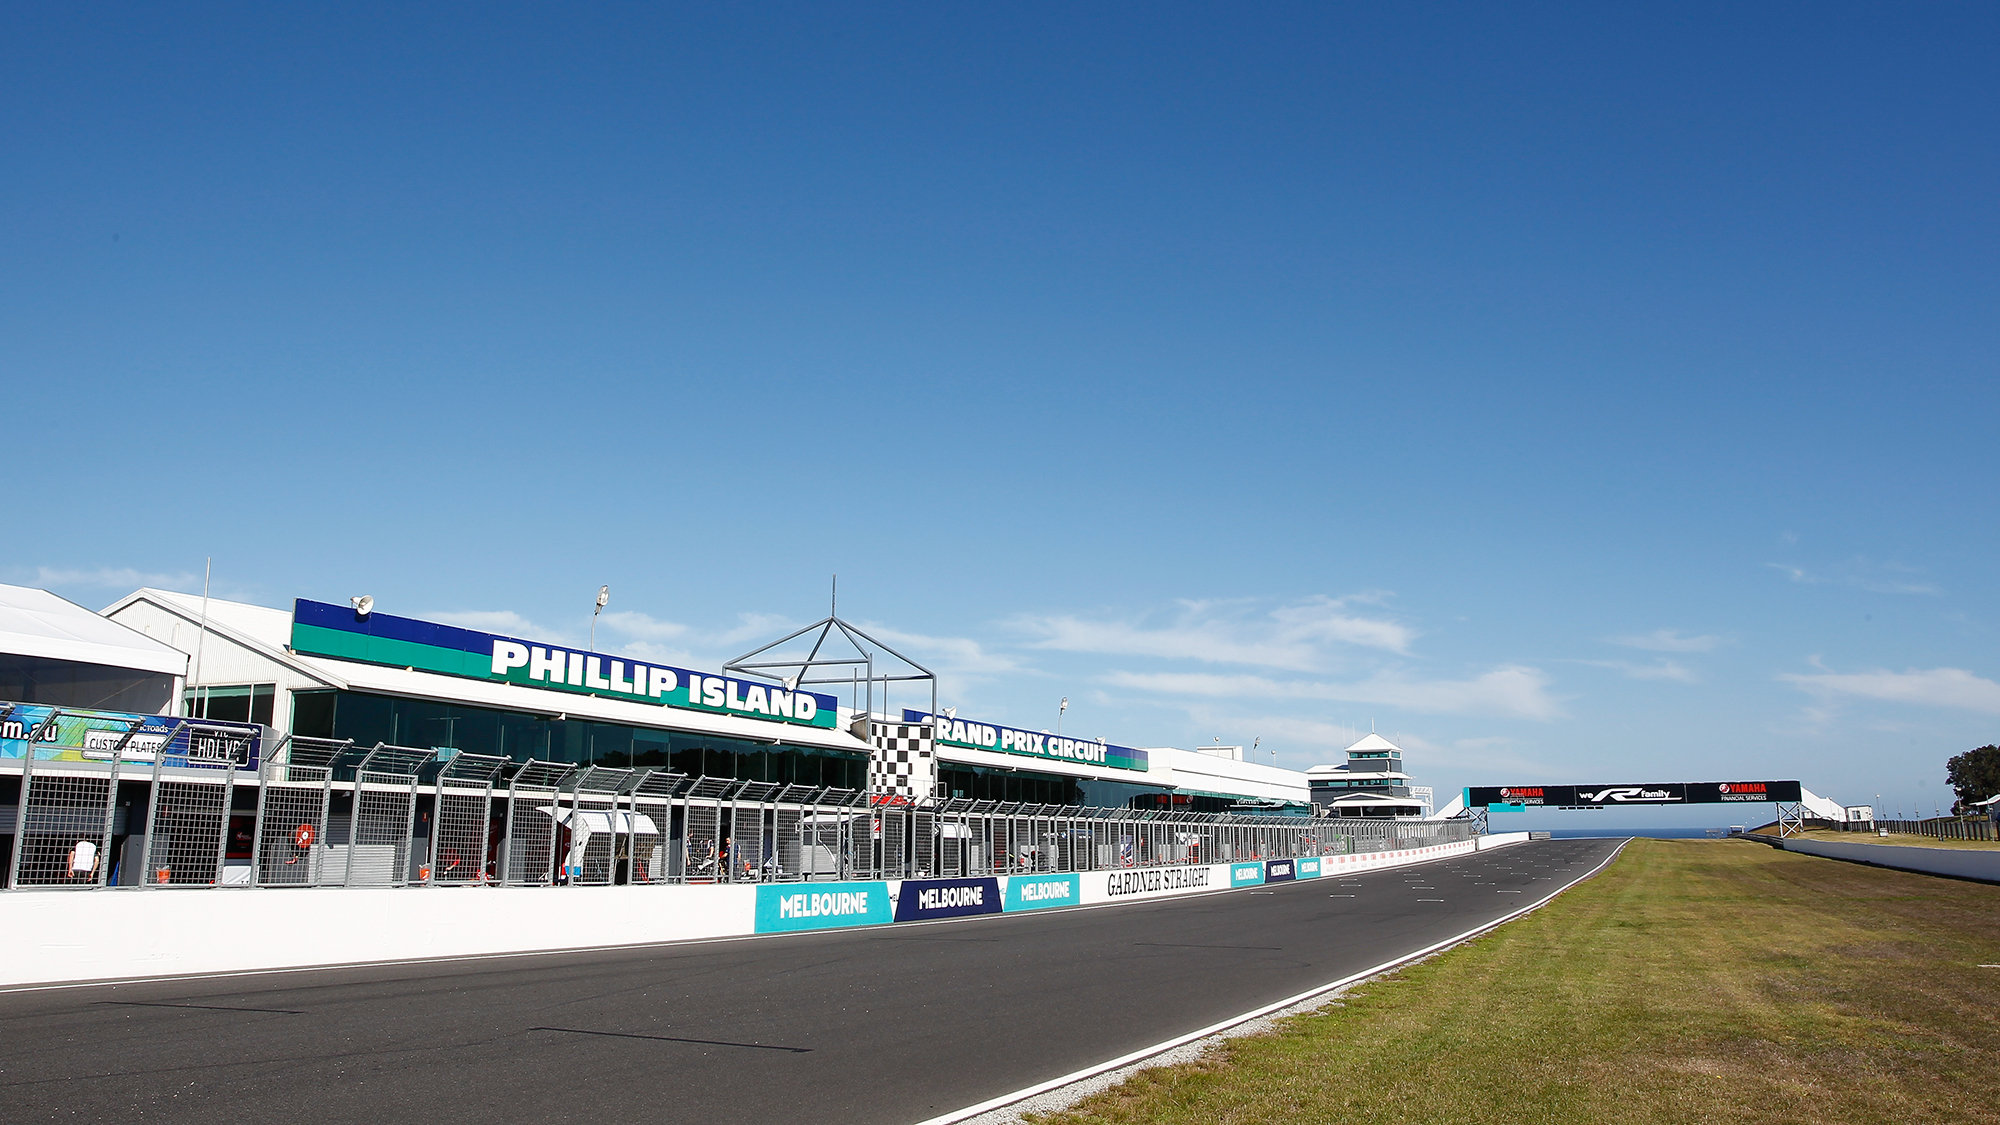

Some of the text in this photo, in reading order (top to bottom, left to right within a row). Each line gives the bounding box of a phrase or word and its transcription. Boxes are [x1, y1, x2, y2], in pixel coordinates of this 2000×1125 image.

[491, 639, 818, 721] PHILLIP ISLAND
[1001, 728, 1046, 755] PRIX
[1047, 737, 1107, 763] CIRCUIT
[1510, 788, 1544, 797] YAMAHA
[1641, 790, 1671, 799] family
[1730, 783, 1767, 793] YAMAHA
[1021, 880, 1070, 902] MELBOURNE
[1107, 867, 1210, 897] GARDNER STRAIGHT
[780, 891, 868, 919] MELBOURNE
[919, 886, 983, 910] MELBOURNE
